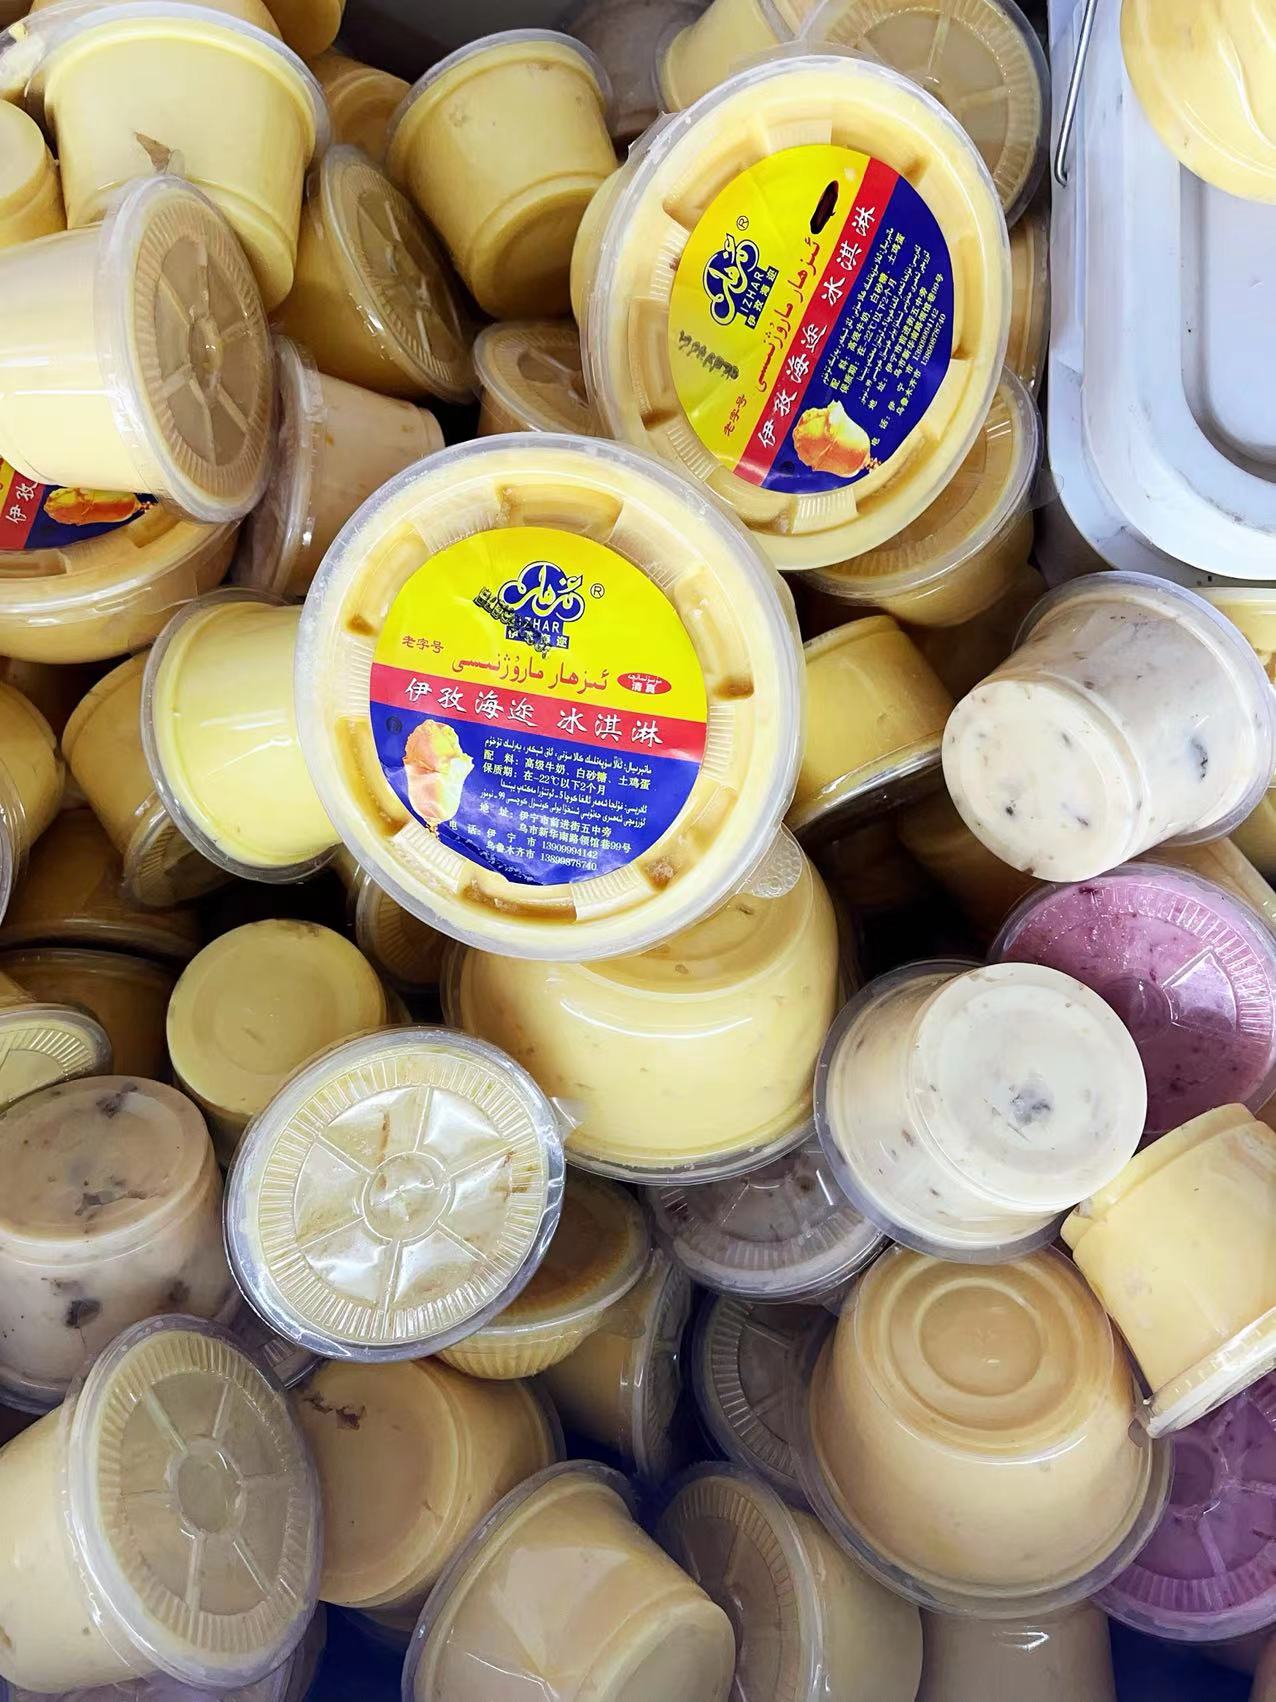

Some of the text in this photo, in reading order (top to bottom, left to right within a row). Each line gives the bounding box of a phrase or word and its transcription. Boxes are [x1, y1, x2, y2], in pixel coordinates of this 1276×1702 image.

[821, 206, 875, 305] 冰淇淋
[739, 270, 764, 313] IZHAR
[723, 393, 747, 437] 老字号
[401, 634, 444, 654] 老字号
[630, 679, 656, 694] 清真
[556, 707, 662, 747] 冰淇淋
[485, 840, 535, 859] 乌鲁木齐市
[541, 840, 599, 859] 13909994142
